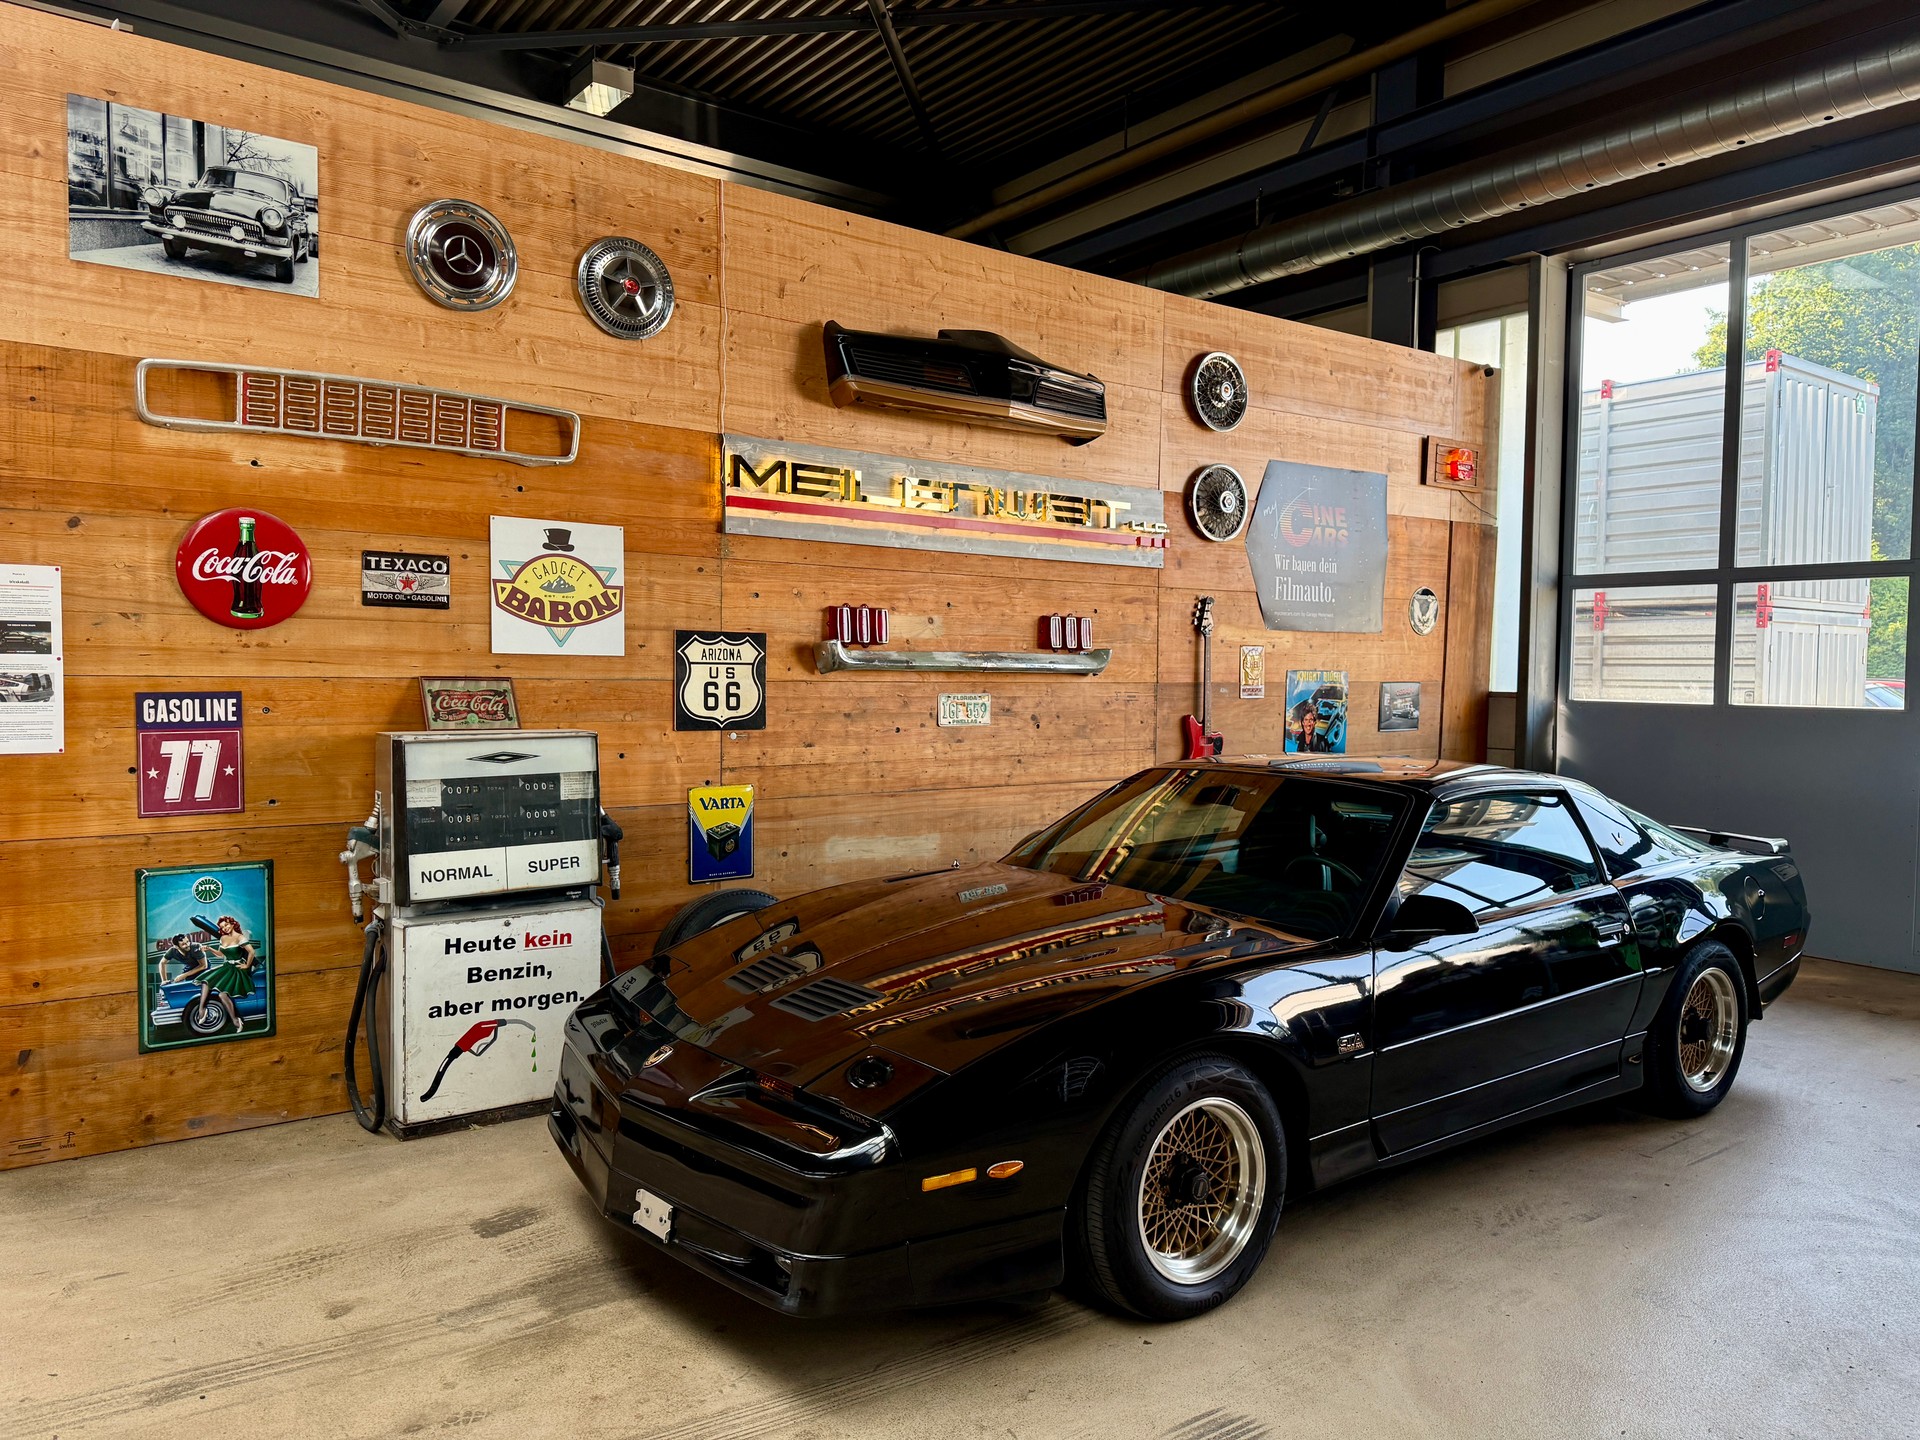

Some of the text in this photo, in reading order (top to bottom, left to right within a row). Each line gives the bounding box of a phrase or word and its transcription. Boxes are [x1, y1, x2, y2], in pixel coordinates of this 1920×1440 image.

[1128, 520, 1170, 533] LLC.
[192, 547, 299, 585] Coca-Cola
[367, 556, 447, 573] TEXACO
[532, 561, 586, 581] GADGET
[1274, 554, 1337, 573] Wir bauen dein
[367, 592, 393, 600] MOTOR
[411, 595, 447, 604] GASOLINE
[1274, 576, 1335, 603] Filmauto.
[501, 585, 618, 622] BARON
[701, 648, 742, 661] ARIZONA
[1297, 671, 1321, 681] KNIGHT
[703, 681, 741, 711] 66
[143, 698, 237, 723] GASOLINE
[966, 702, 987, 719] 559
[160, 739, 222, 803] 77
[699, 797, 745, 810] VARTA
[528, 856, 580, 873] SUPER
[421, 865, 493, 884] NORMAL
[444, 929, 573, 955] Heute kein
[467, 962, 553, 984] Benzin,
[428, 989, 585, 1019] aber morgen.
[1174, 1087, 1182, 1098] 6
[840, 1108, 871, 1128] PONTIAC
